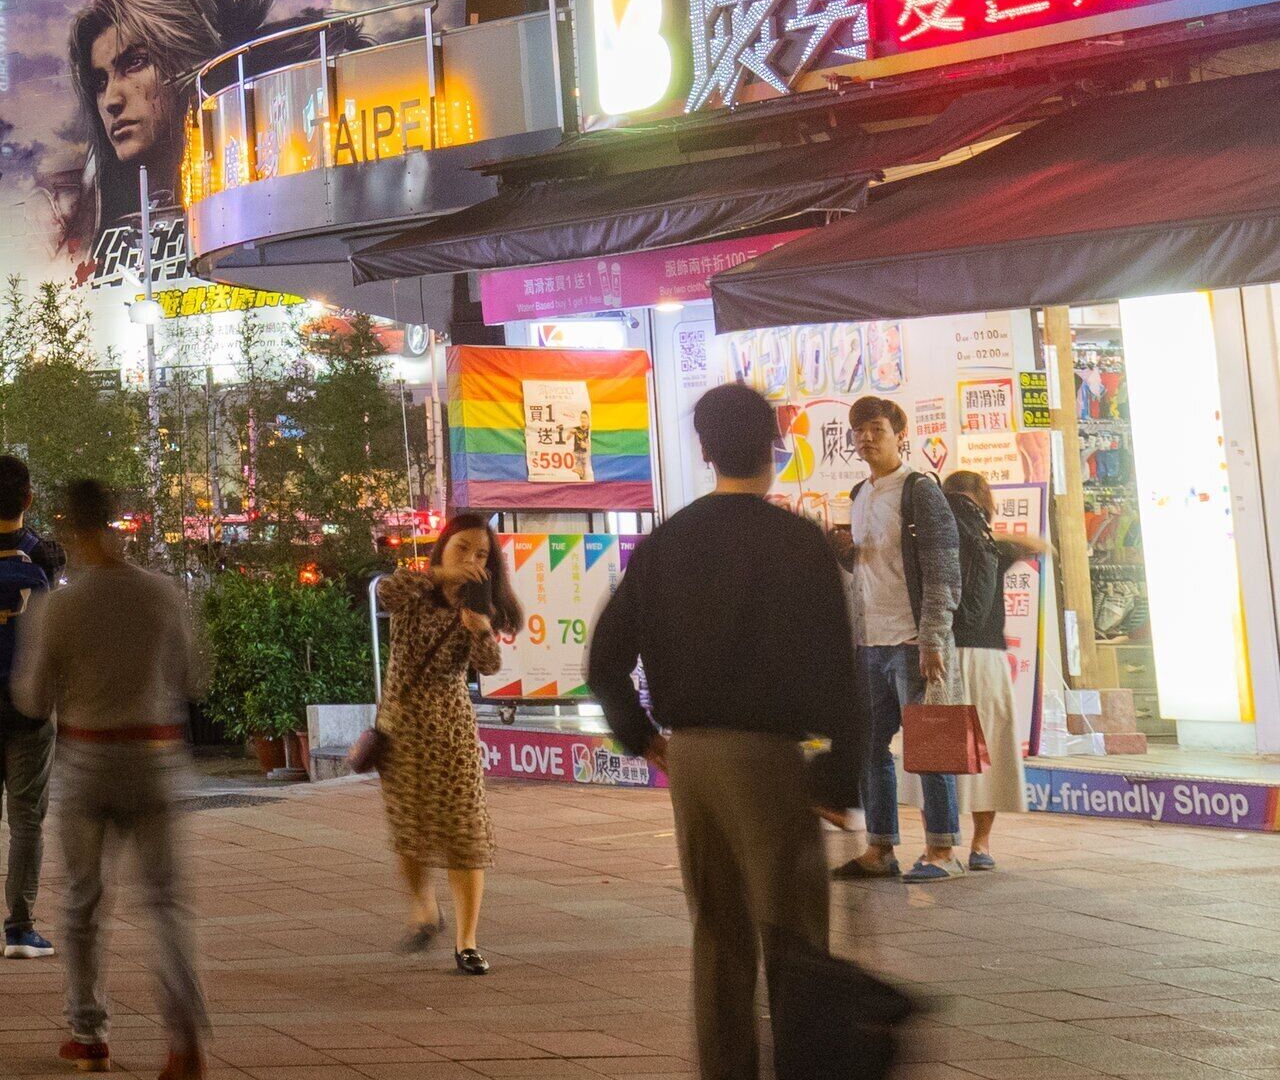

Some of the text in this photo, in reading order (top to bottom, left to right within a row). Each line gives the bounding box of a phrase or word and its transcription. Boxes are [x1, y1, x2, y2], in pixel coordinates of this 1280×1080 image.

[966, 389, 1006, 408] 潤滑液
[530, 405, 555, 422] 買1
[967, 412, 1008, 430] 買1送1
[538, 425, 565, 445] 送1
[968, 441, 1011, 451] Underwear
[532, 452, 575, 469] $590
[516, 542, 532, 550] MON
[551, 542, 566, 550] TUE
[586, 542, 603, 550] WED
[557, 619, 587, 645] 79
[510, 744, 564, 775] LOVE
[1026, 781, 1249, 823] ay-friendly Shop
